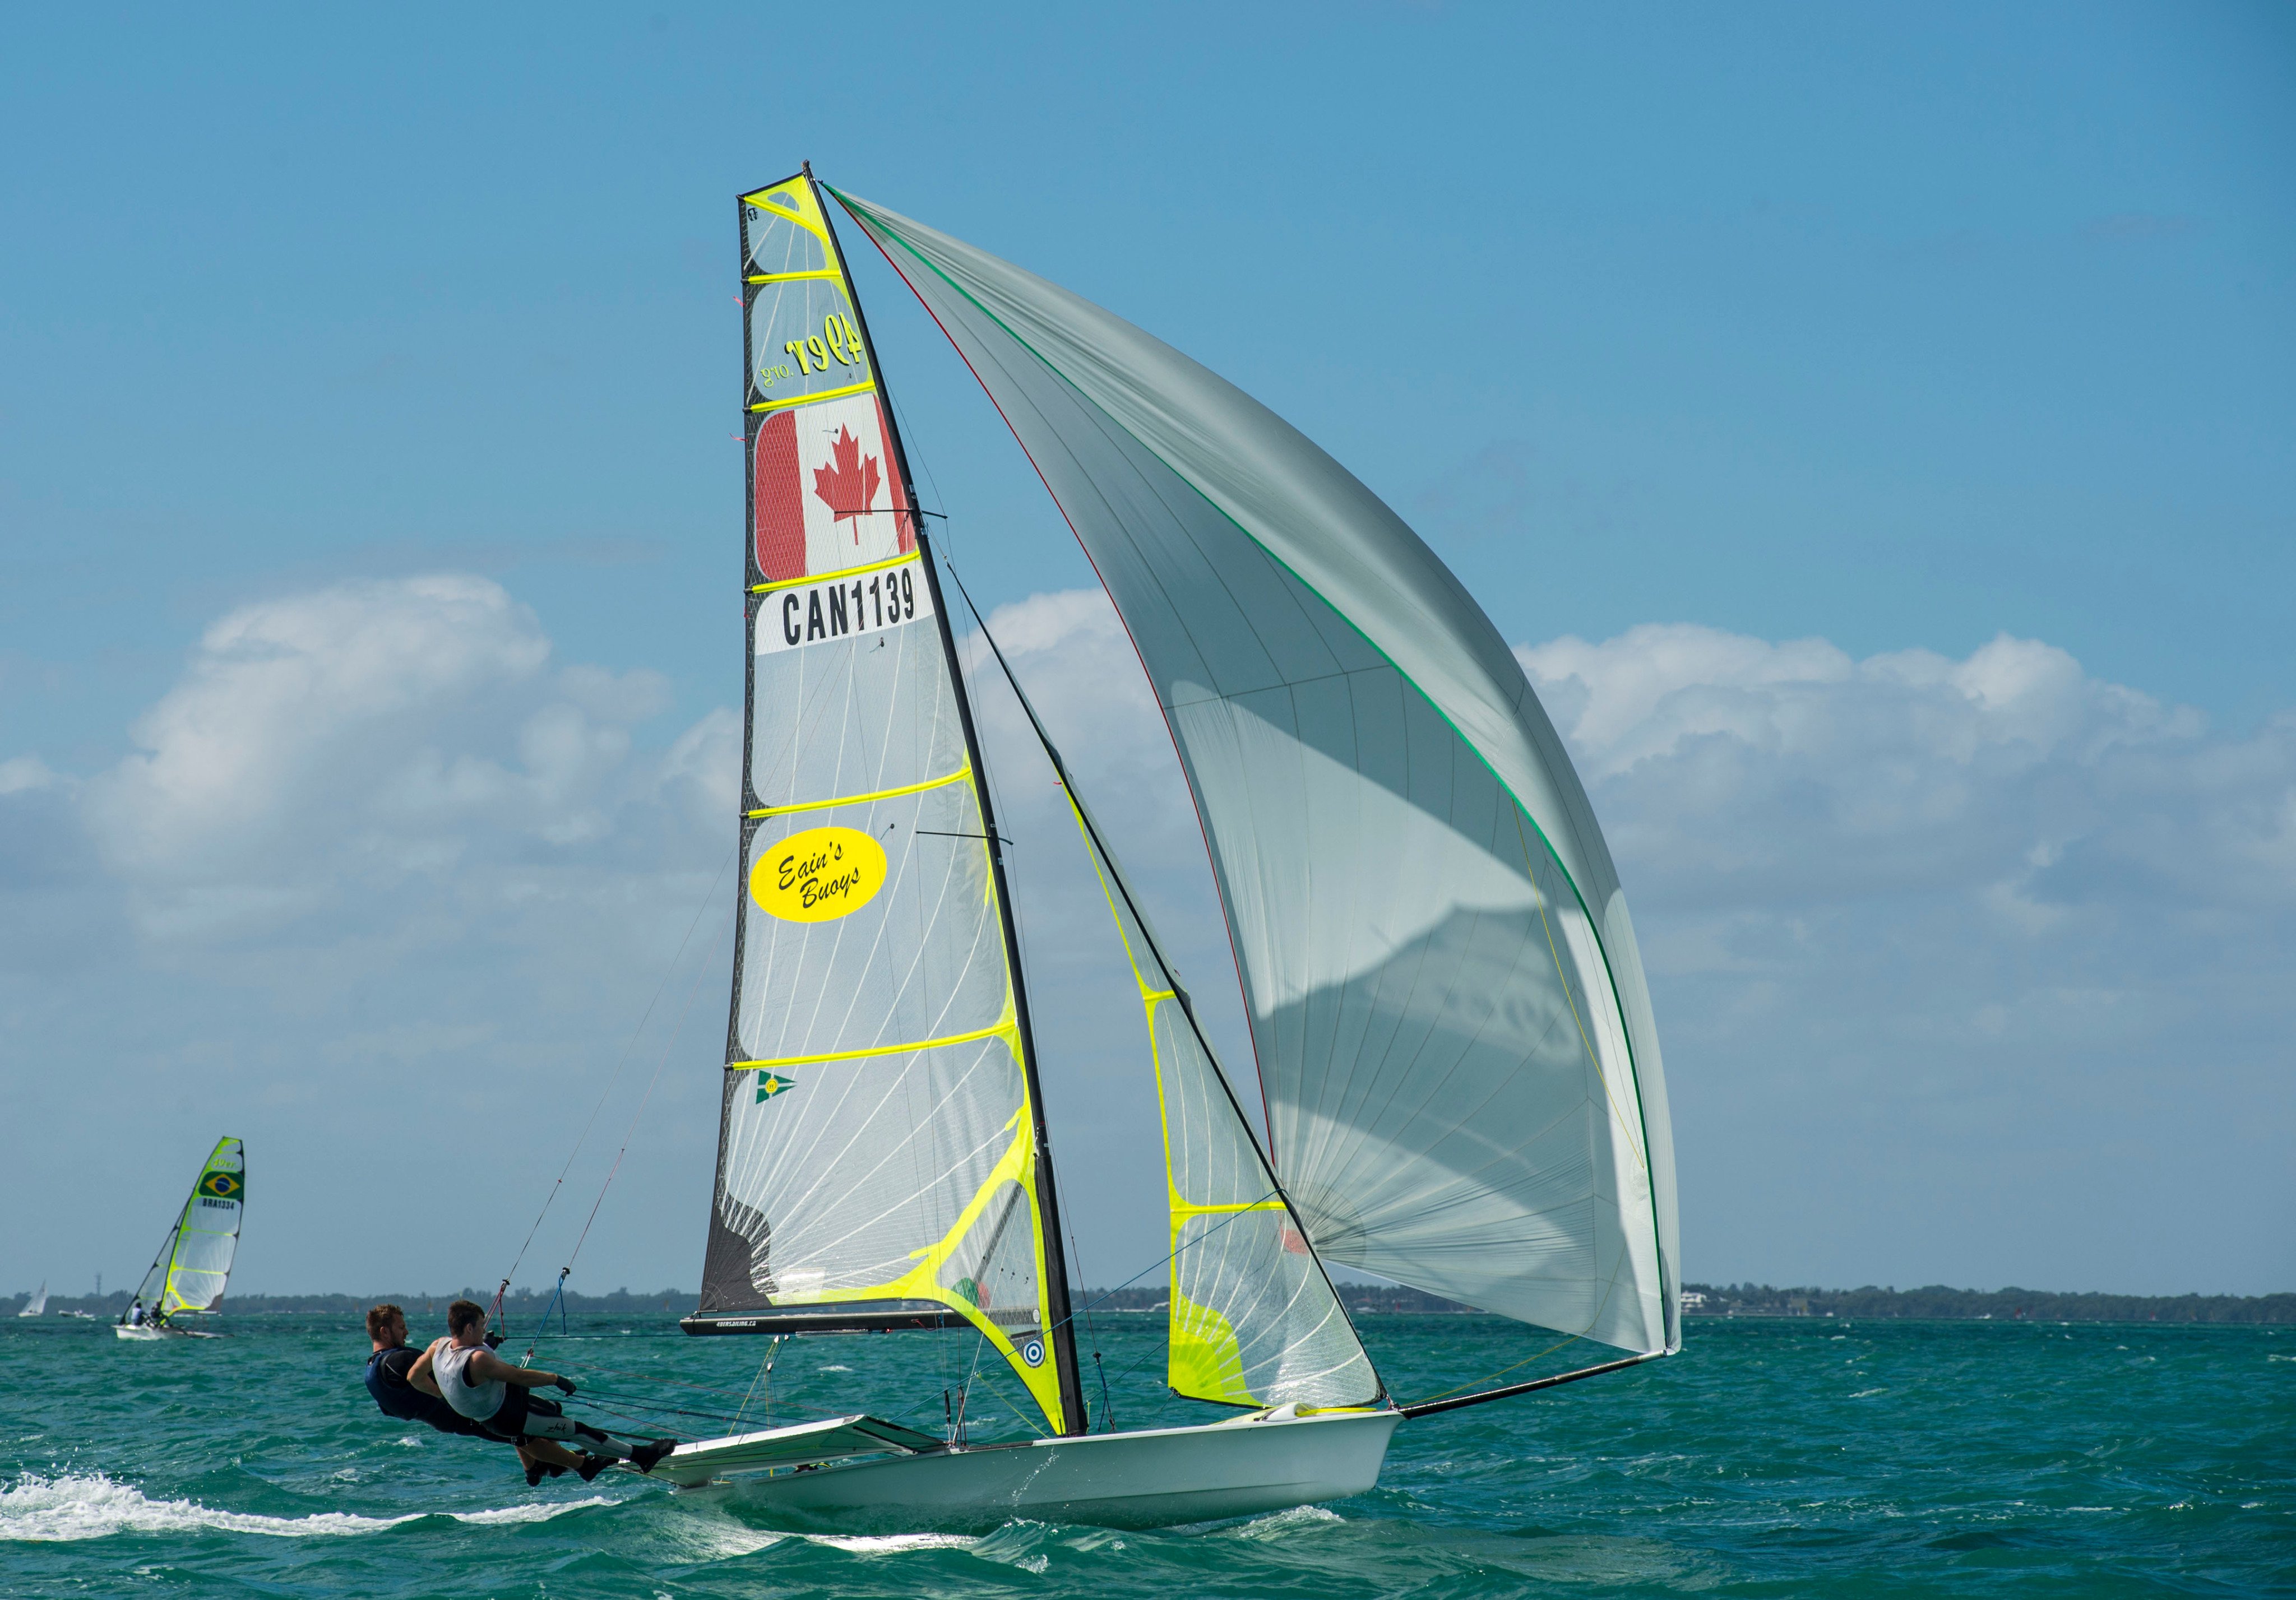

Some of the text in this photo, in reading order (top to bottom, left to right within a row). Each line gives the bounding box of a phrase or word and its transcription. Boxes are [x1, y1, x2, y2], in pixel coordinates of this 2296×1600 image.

[783, 568, 914, 646] CAN1139
[779, 841, 844, 890] Eain's
[799, 867, 861, 908] Buoys
[202, 1198, 234, 1209] BRA1334
